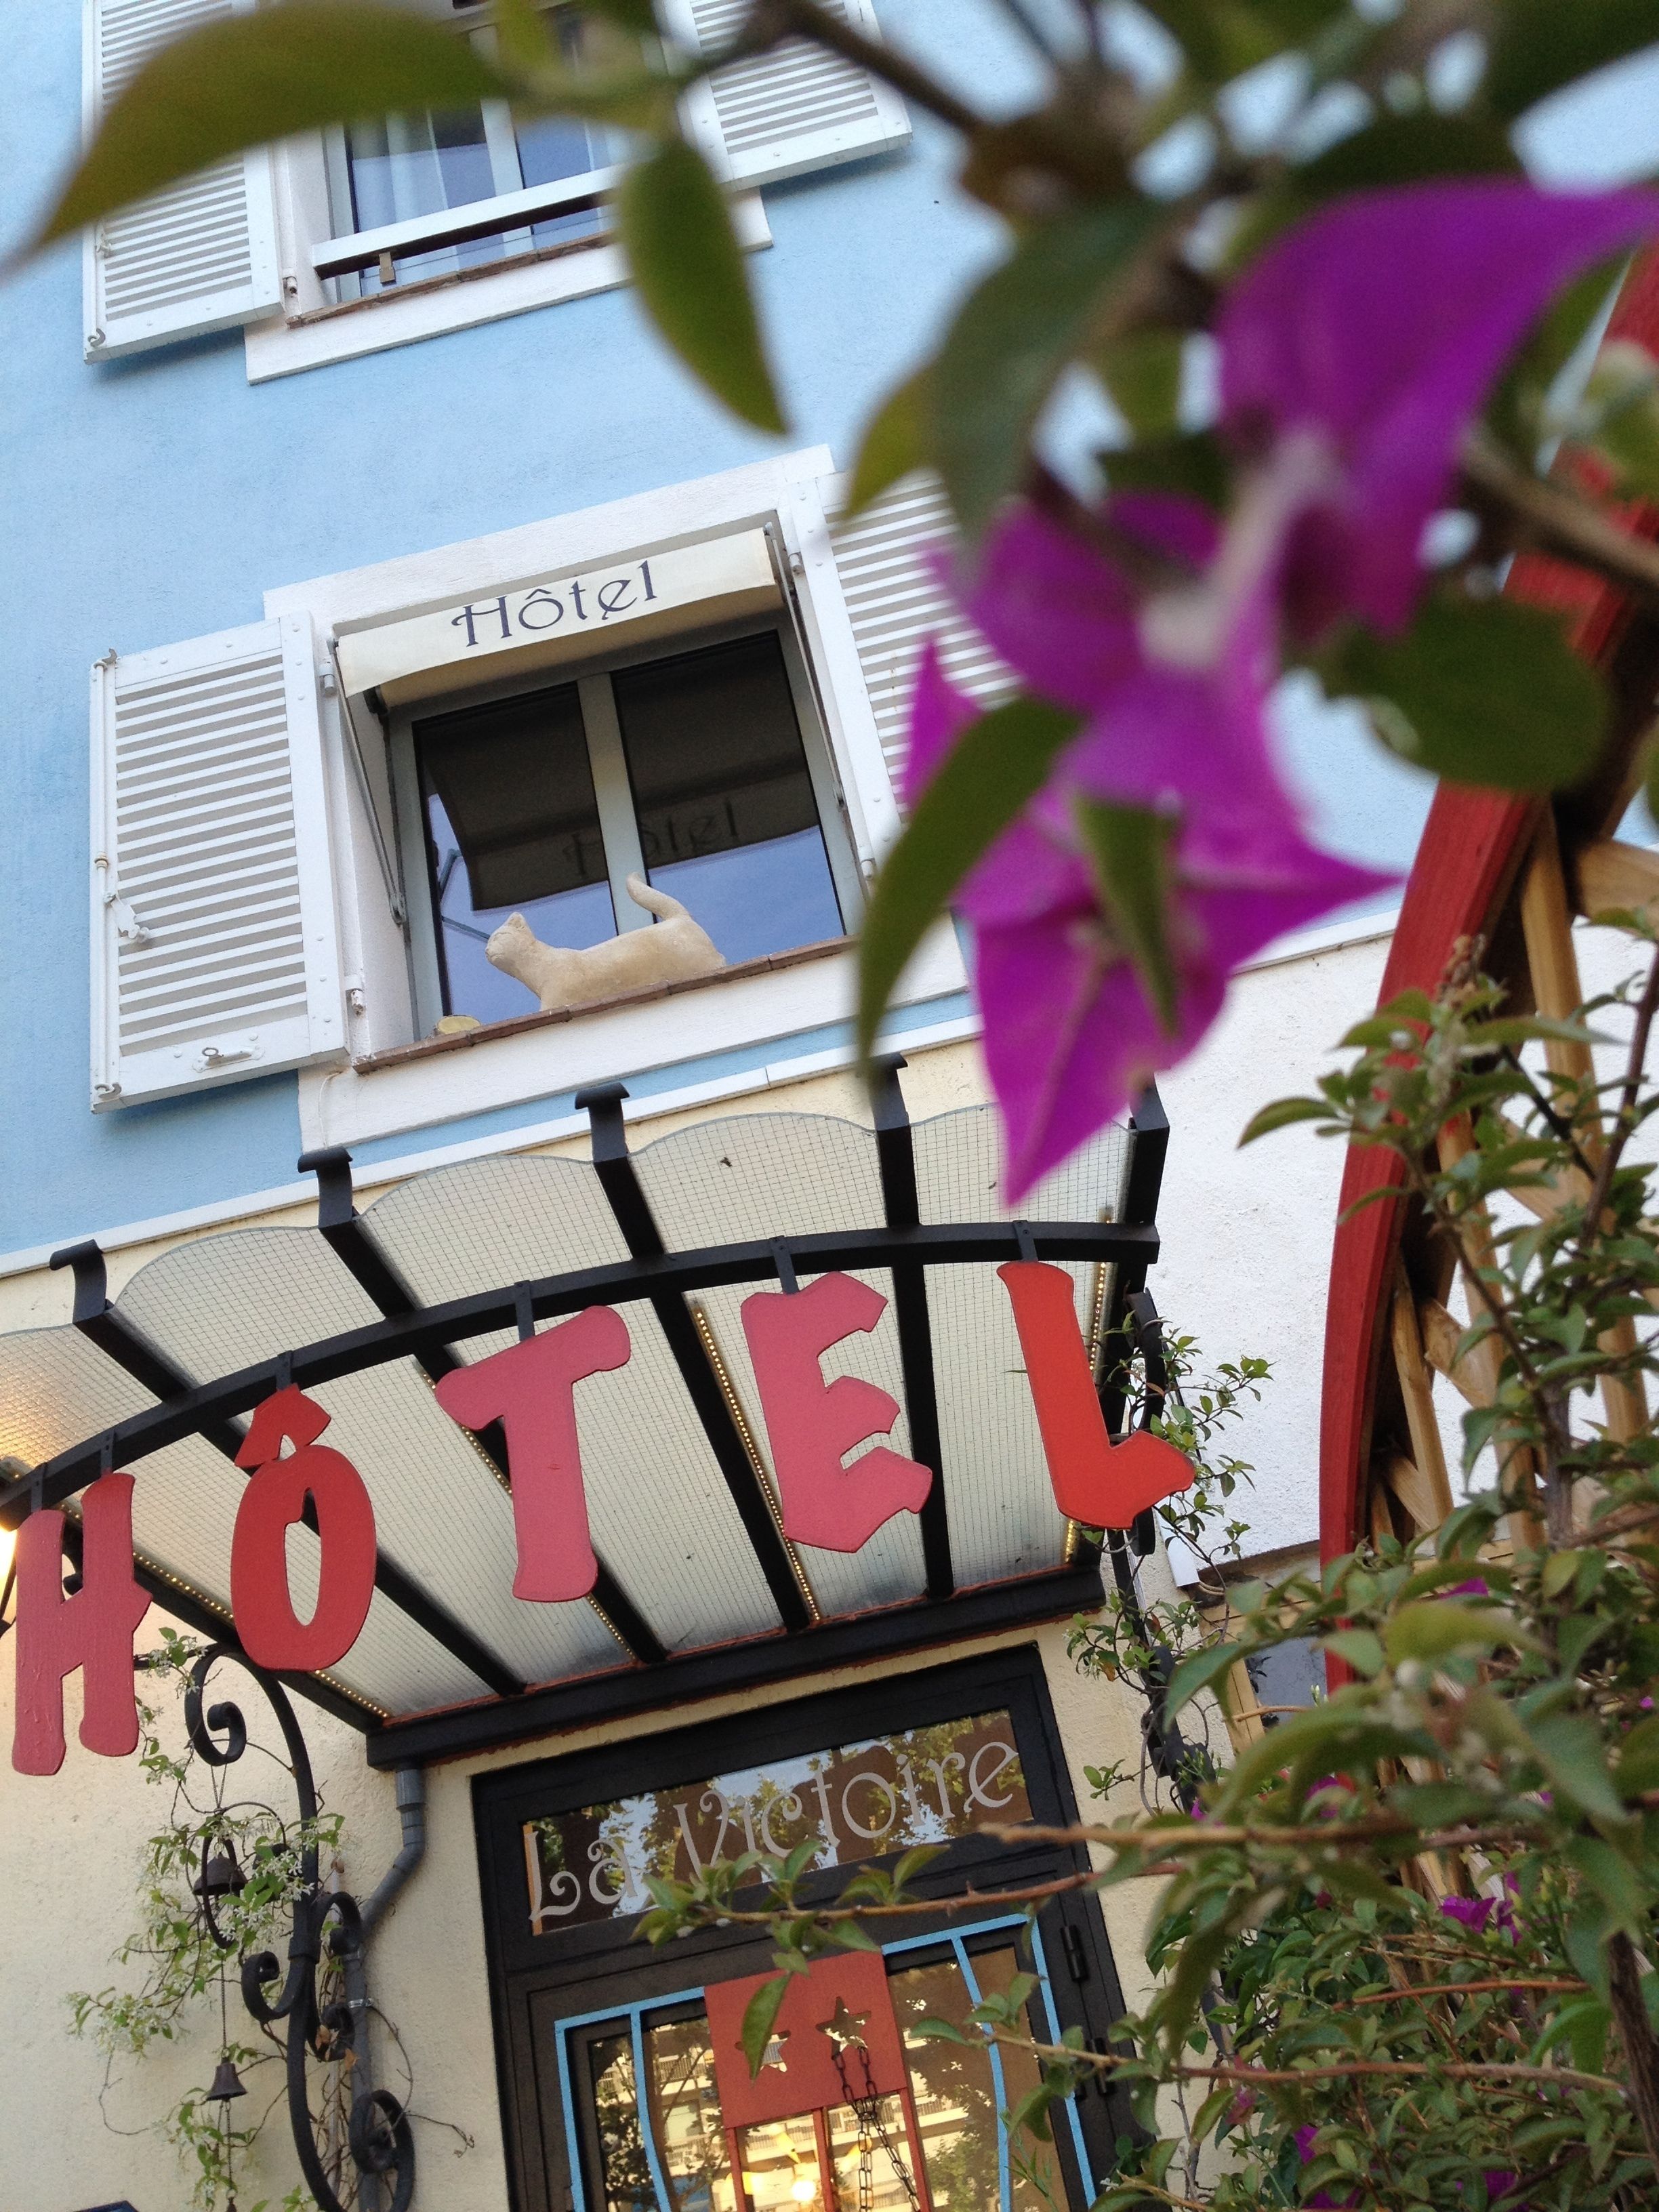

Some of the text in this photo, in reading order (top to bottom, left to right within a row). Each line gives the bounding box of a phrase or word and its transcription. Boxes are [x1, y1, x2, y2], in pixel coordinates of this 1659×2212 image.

[451, 560, 658, 648] Hôtel
[12, 1261, 1195, 1776] HÔTEL
[529, 1740, 1019, 1922] La Victoire
